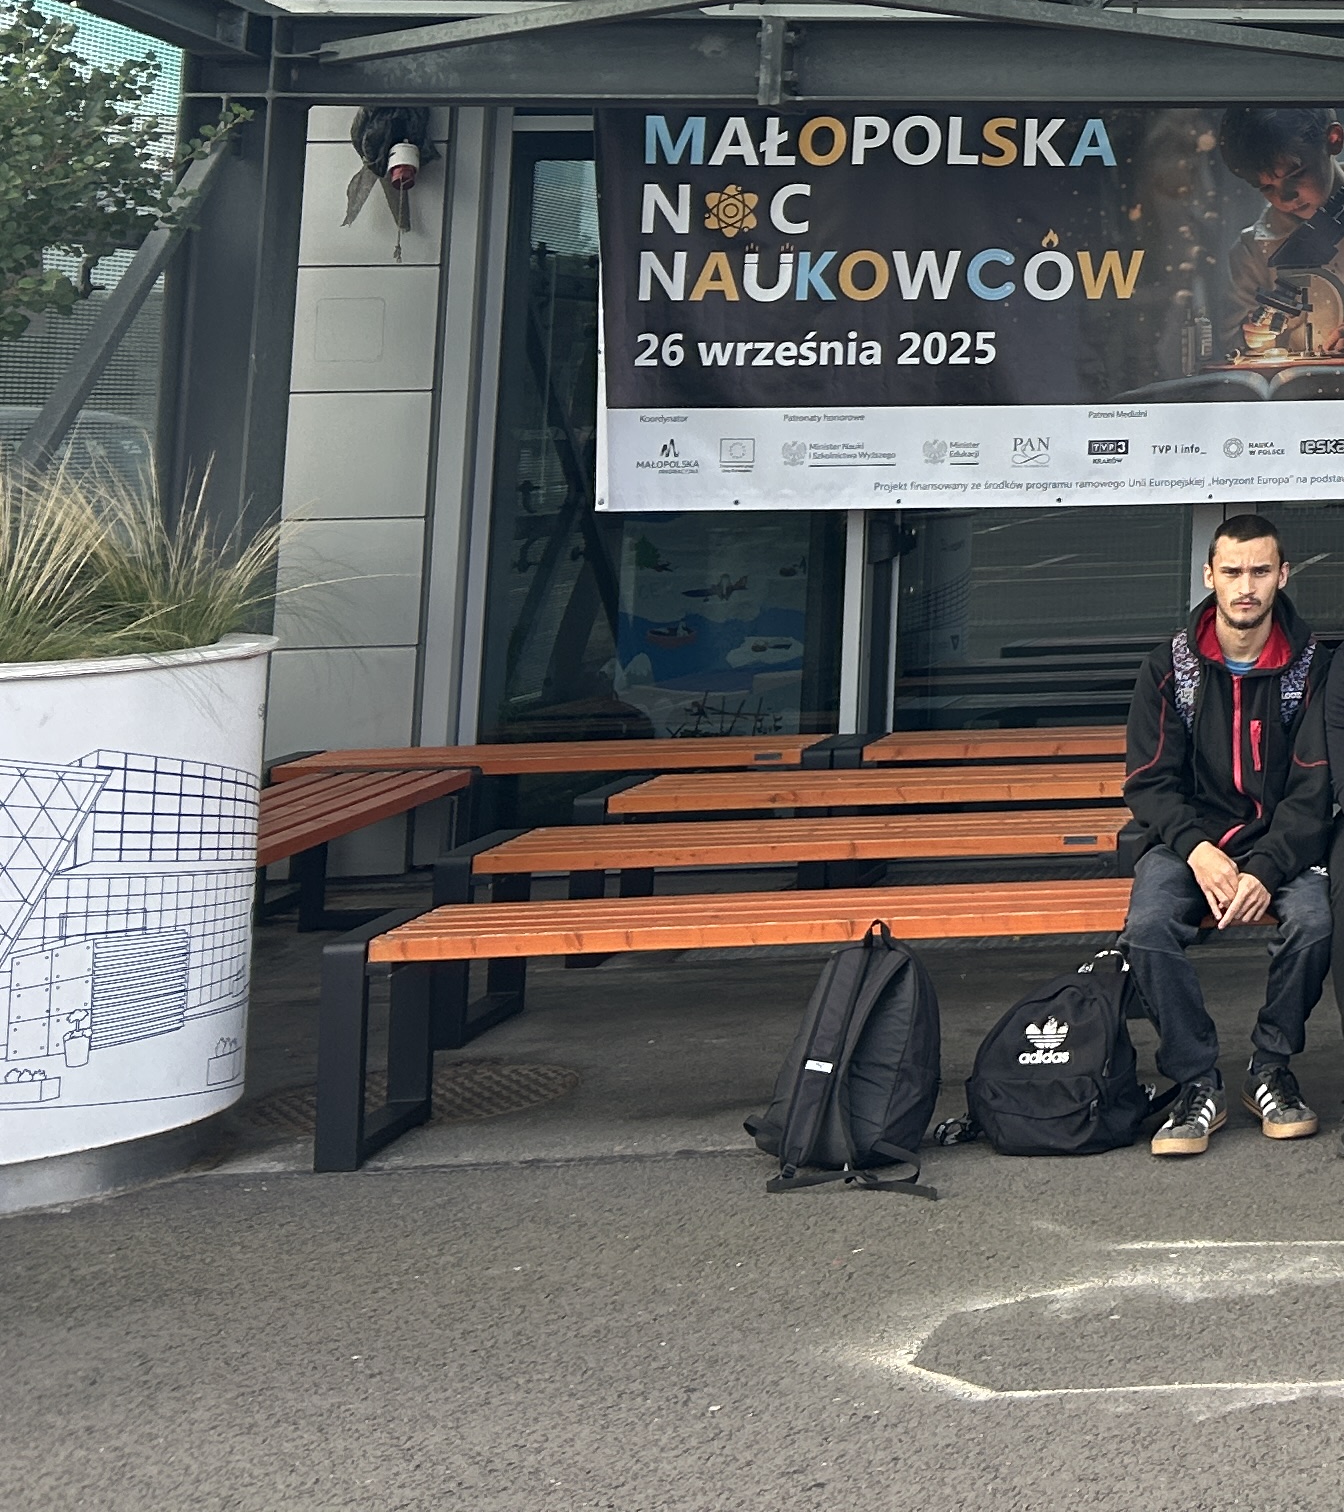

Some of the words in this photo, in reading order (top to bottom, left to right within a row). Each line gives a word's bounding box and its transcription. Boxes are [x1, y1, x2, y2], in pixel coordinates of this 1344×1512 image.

[645, 115, 1117, 167] MAŁOPOLSKA
[638, 230, 1145, 302] NAUKOWCÓW
[634, 333, 685, 368] 26
[699, 331, 882, 367] września
[897, 331, 998, 366] 2025
[1012, 437, 1051, 452] PAN
[1152, 445, 1172, 455] TVP
[874, 481, 908, 493] Projekt
[910, 480, 969, 492] finansowany
[1025, 481, 1073, 492] programu
[1075, 480, 1126, 490] ramowego
[1296, 476, 1308, 484] na
[1018, 1049, 1070, 1064] adidas
